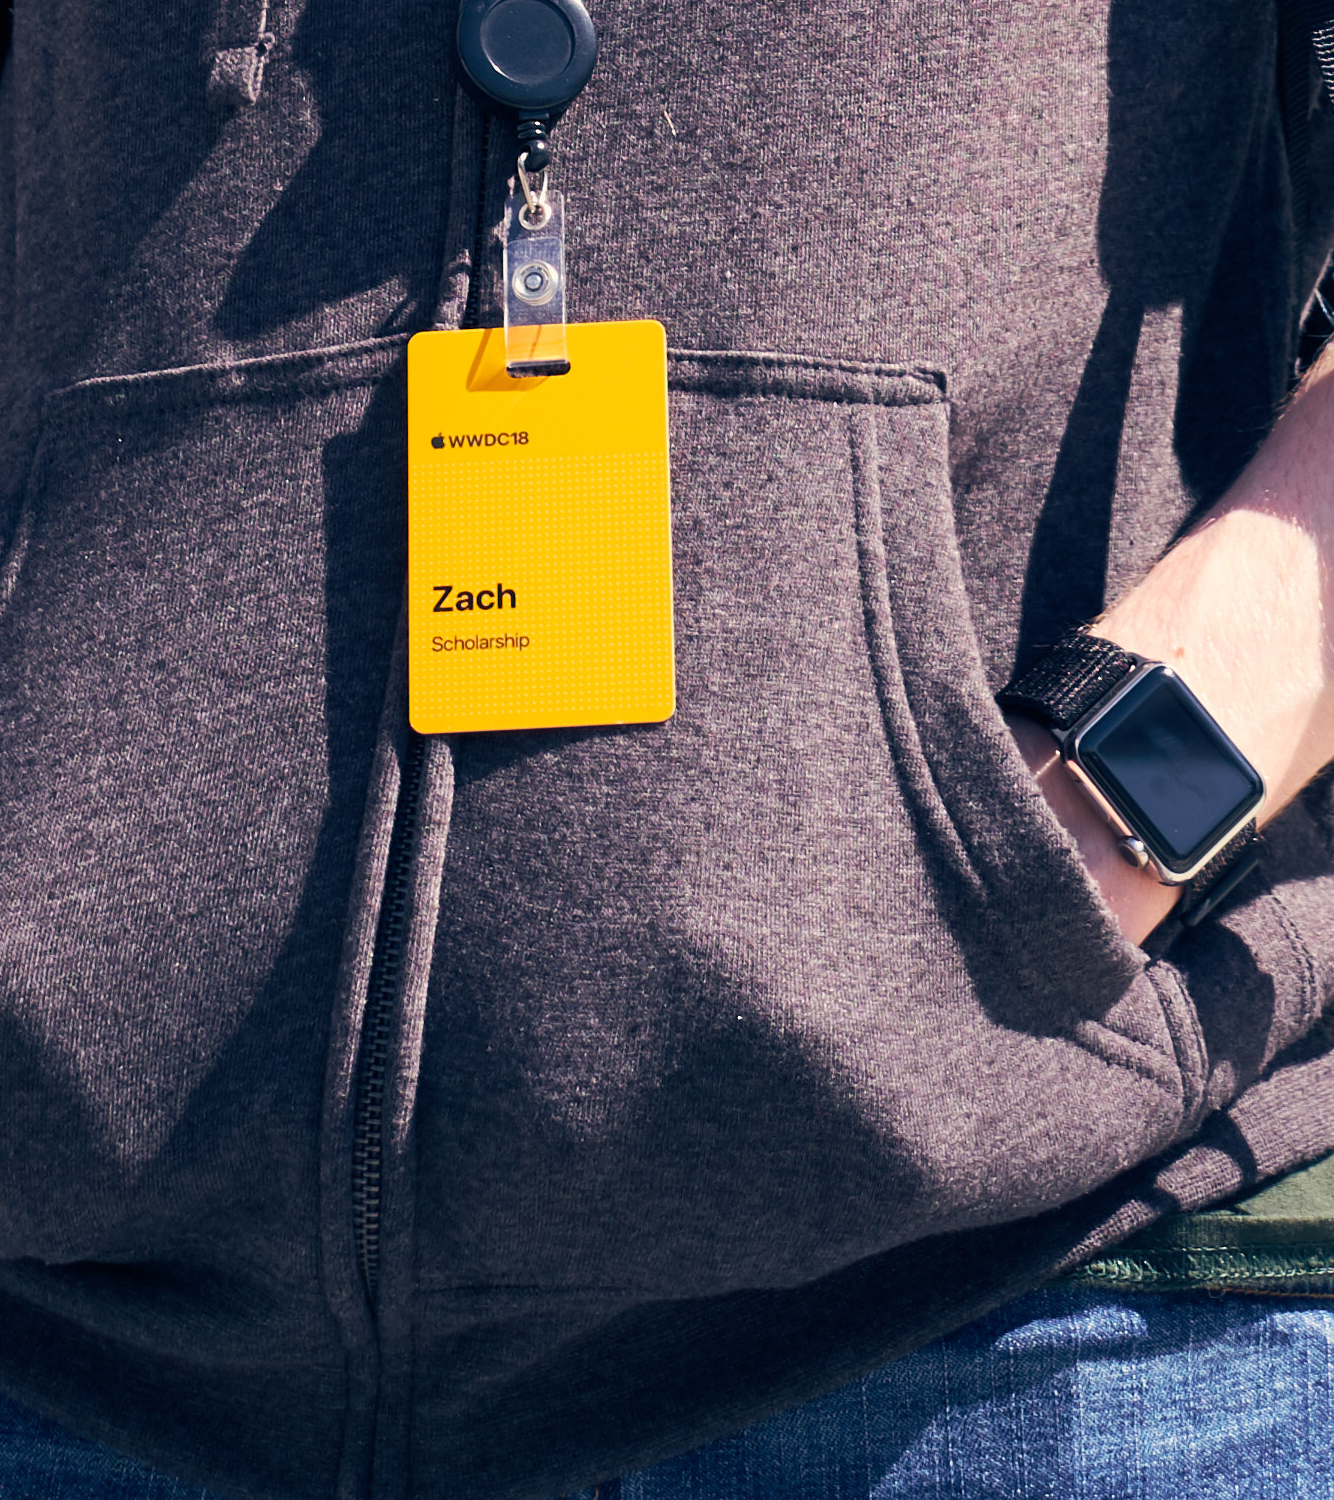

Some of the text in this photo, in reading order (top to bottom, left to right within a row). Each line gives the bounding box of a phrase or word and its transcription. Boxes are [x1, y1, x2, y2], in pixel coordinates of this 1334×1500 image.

[448, 431, 529, 449] WWDC18
[432, 583, 517, 612] Zach
[431, 632, 530, 652] Scholarship
